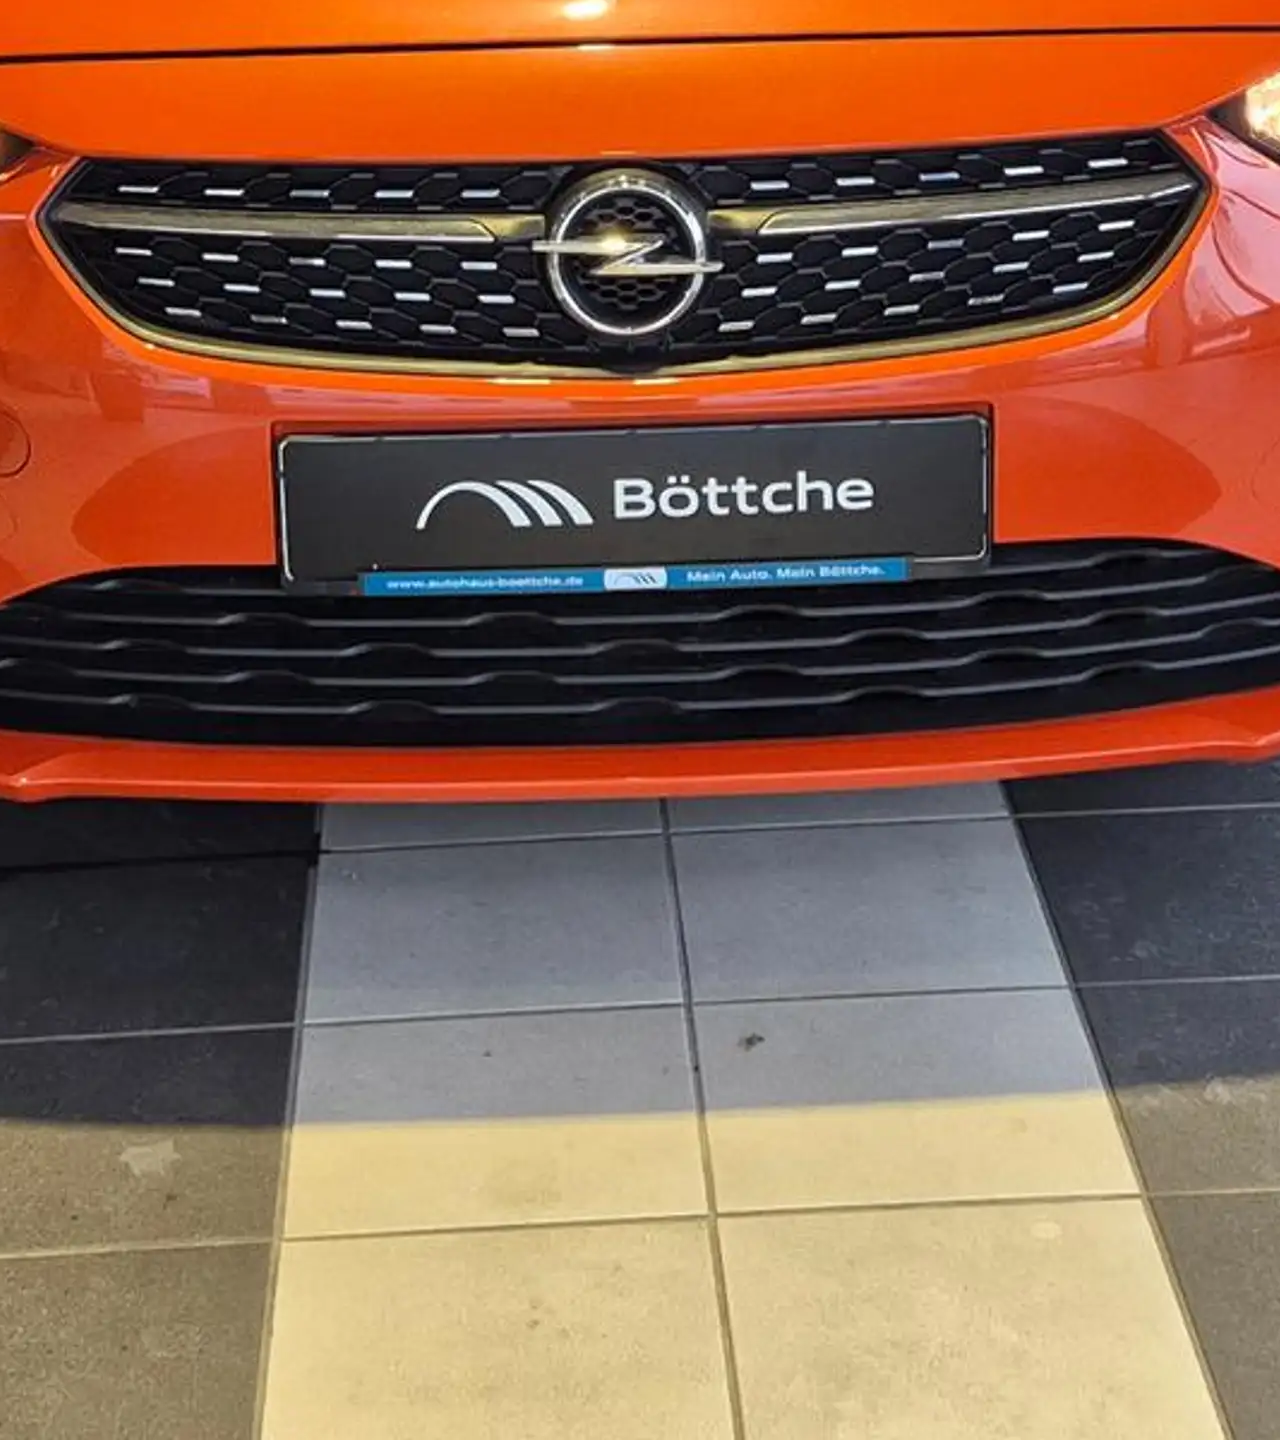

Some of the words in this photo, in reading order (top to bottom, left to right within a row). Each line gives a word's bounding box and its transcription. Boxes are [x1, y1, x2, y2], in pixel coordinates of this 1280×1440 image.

[613, 470, 875, 520] Böttche
[686, 569, 726, 583] Mein
[730, 568, 774, 581] Auto.
[776, 565, 816, 579] Mein
